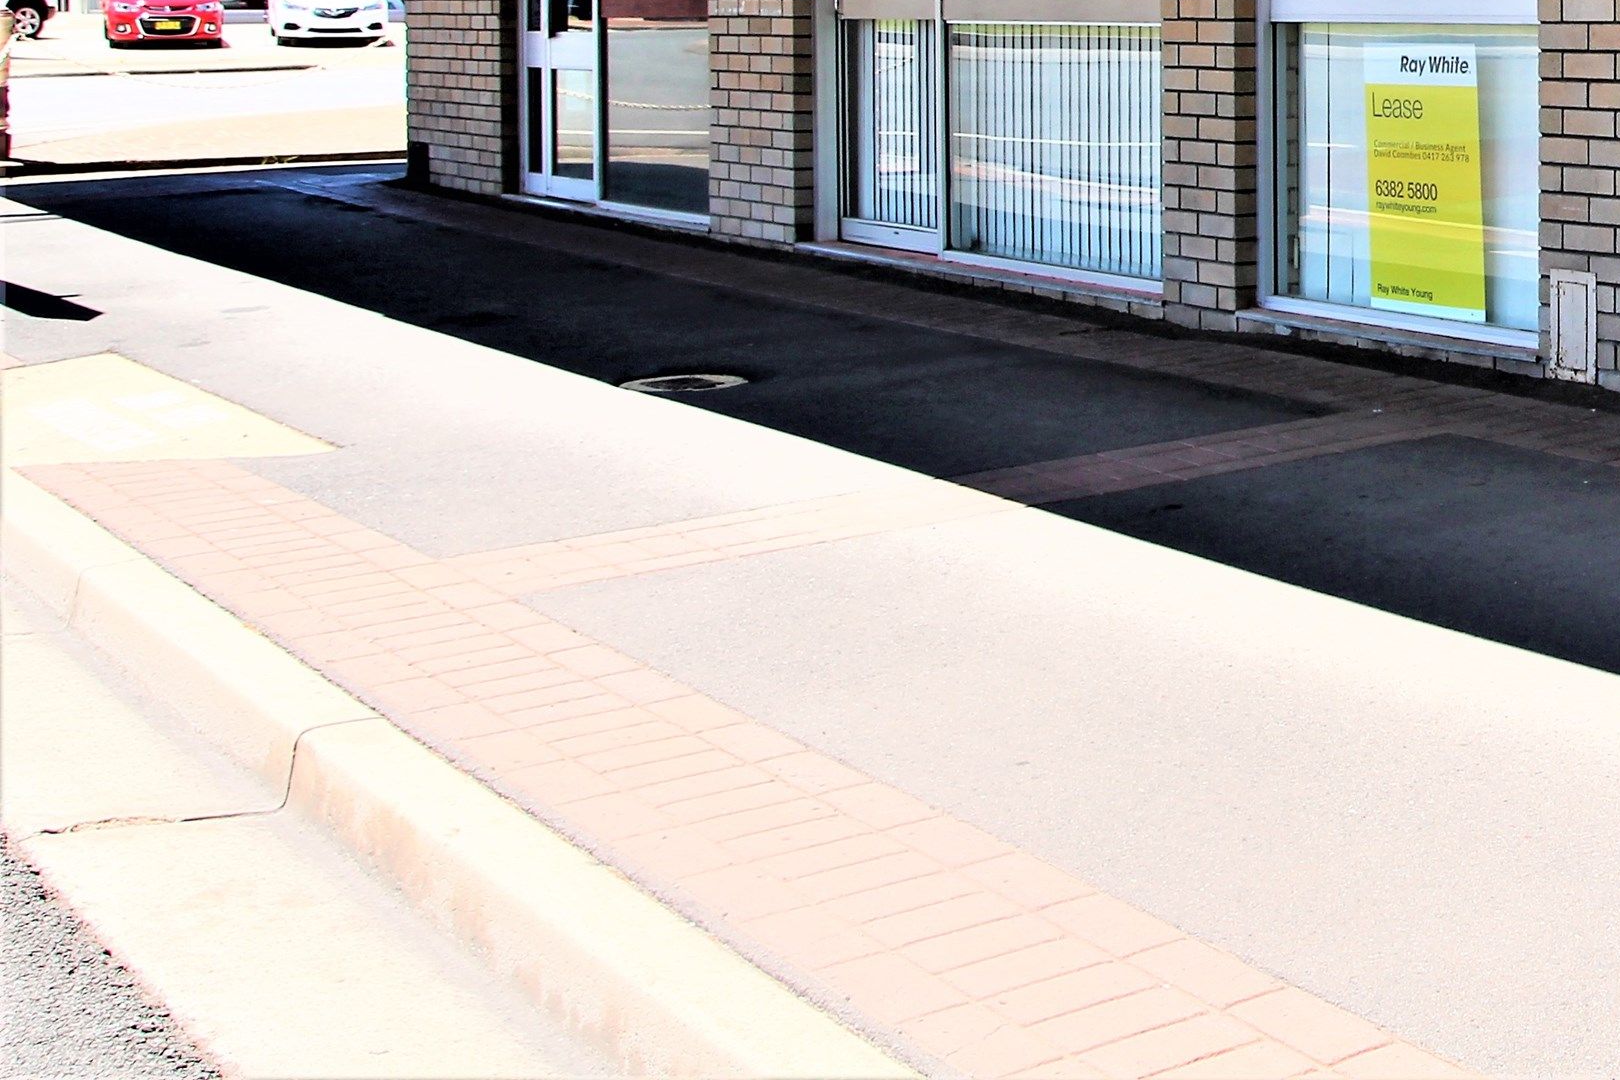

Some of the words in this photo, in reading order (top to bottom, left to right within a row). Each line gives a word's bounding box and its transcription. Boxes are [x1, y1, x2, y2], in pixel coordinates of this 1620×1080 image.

[1400, 55, 1426, 76] Ray
[1428, 56, 1469, 74] White
[1372, 91, 1423, 120] Lease
[1374, 149, 1391, 158] David
[1392, 150, 1421, 159] Coombes
[1422, 152, 1439, 161] 0417
[1441, 152, 1454, 162] 263
[1456, 154, 1470, 163] 978
[1415, 141, 1443, 151] Business
[1445, 144, 1466, 154] Agent
[1375, 179, 1404, 199] 6382
[1407, 182, 1438, 201] 5800
[1377, 283, 1389, 296] Ray
[1391, 285, 1409, 296] White
[1411, 288, 1433, 301] Young
